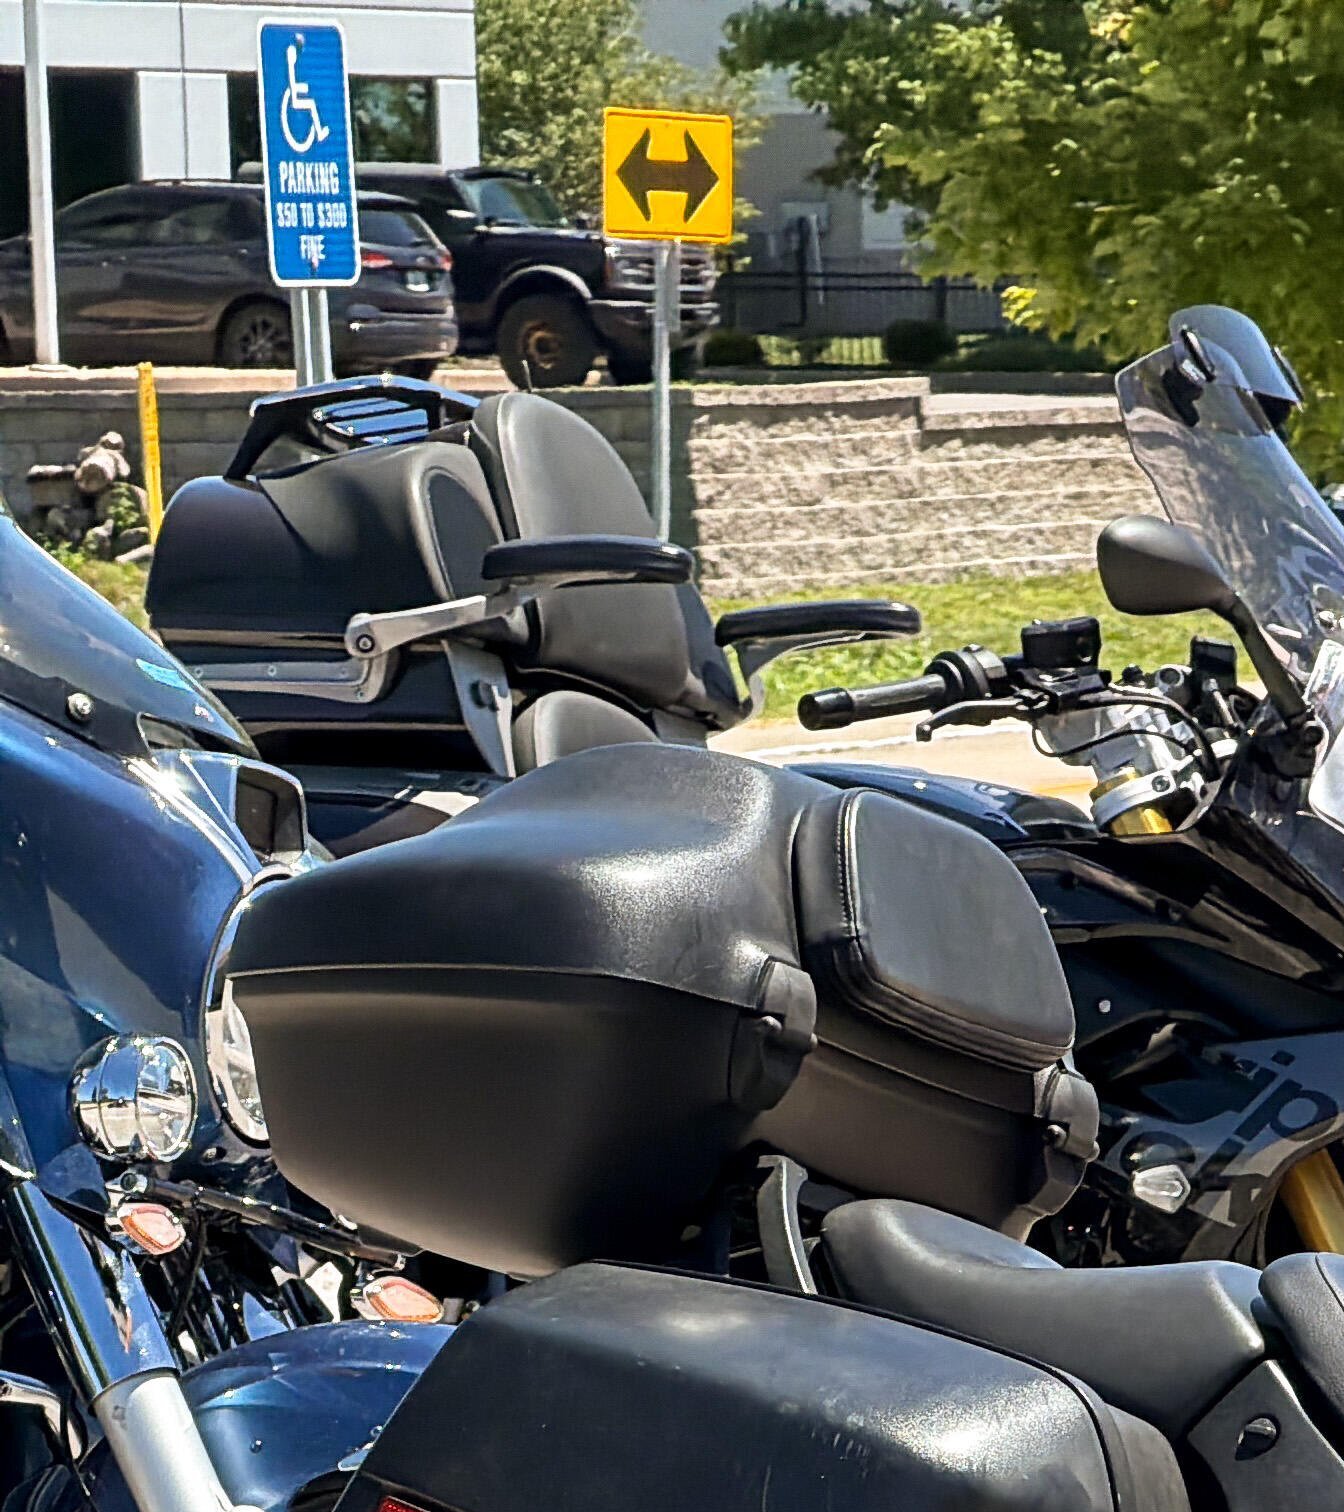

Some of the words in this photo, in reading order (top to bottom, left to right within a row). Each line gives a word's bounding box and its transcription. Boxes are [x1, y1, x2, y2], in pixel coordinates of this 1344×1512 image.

[279, 161, 339, 194] PARKING
[276, 202, 298, 228] $50
[300, 202, 314, 228] TO
[317, 202, 347, 228] $300
[299, 234, 325, 260] FINE
